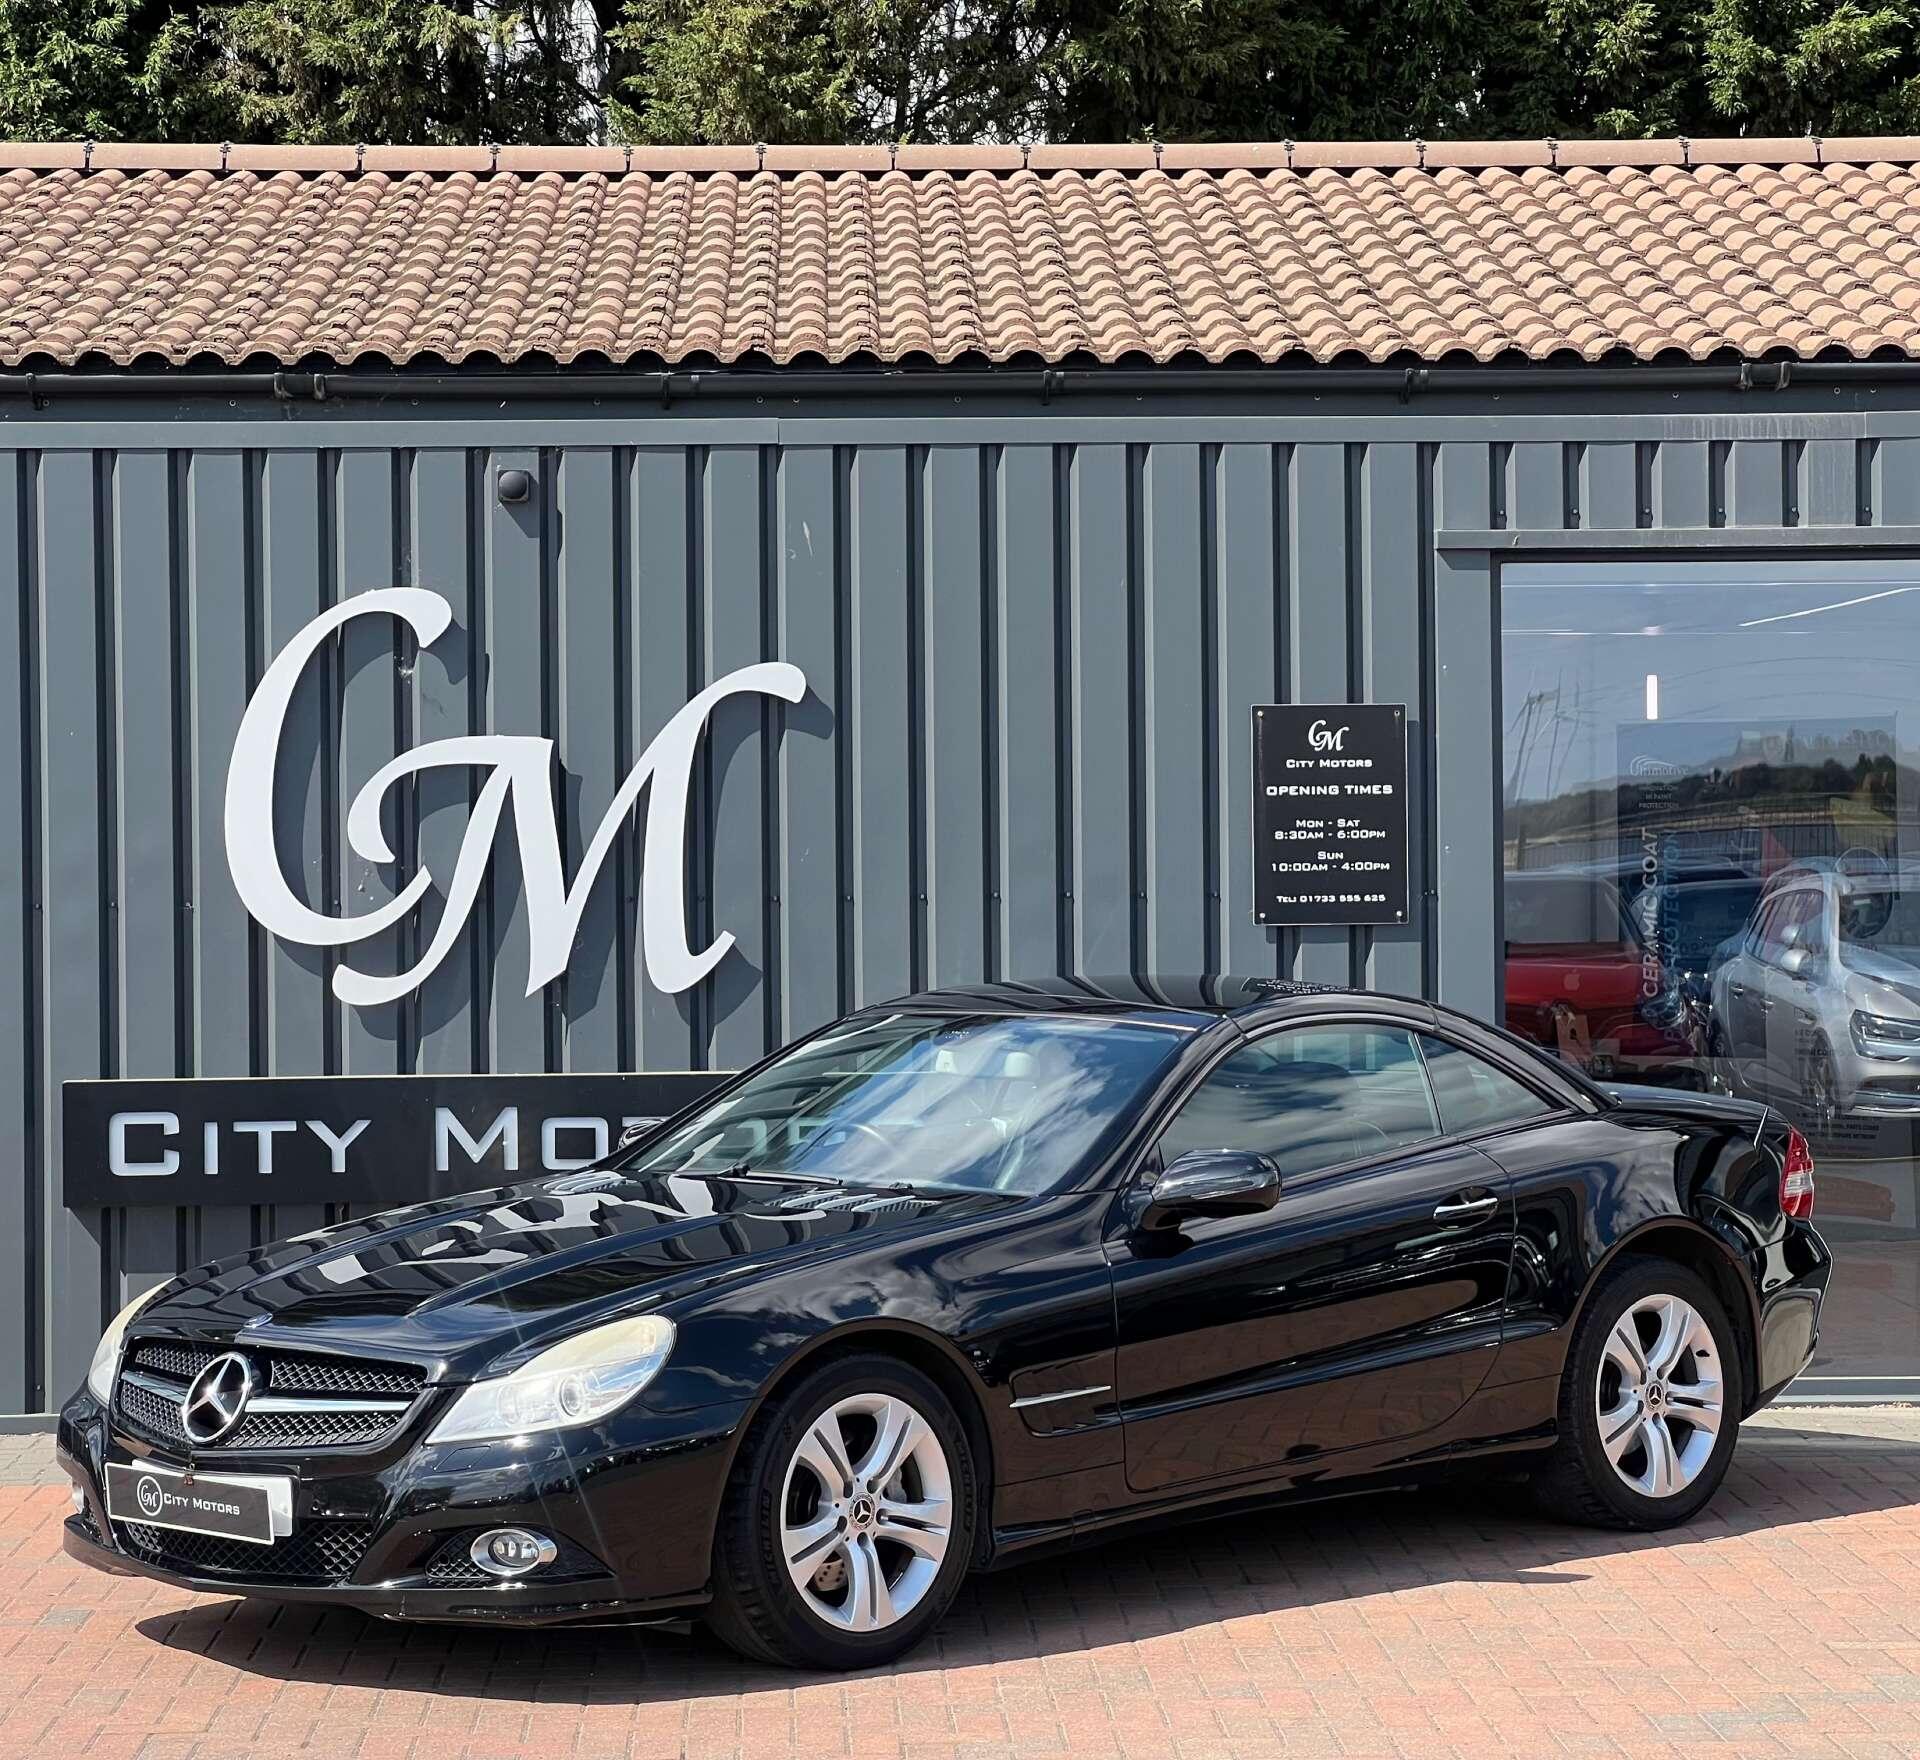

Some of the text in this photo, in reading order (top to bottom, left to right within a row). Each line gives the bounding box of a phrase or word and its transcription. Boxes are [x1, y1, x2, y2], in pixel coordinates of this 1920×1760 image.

[1285, 758, 1373, 769] CITY MOTORS
[1266, 784, 1394, 797] OPENING TIMES
[1295, 819, 1324, 829] MON
[1337, 818, 1361, 828] SAT
[1274, 830, 1324, 840] 8:30AM
[1337, 829, 1386, 839] 6:00PM
[1317, 851, 1344, 860] SUN
[1271, 862, 1328, 872] 10:00AM
[1341, 861, 1390, 871] 4:00PM
[1299, 895, 1336, 903] 01733
[1642, 826, 1658, 998] CERAMIC COAT
[108, 1111, 371, 1177] CITY
[163, 1492, 189, 1507] CITY
[193, 1497, 241, 1516] MOTORS
